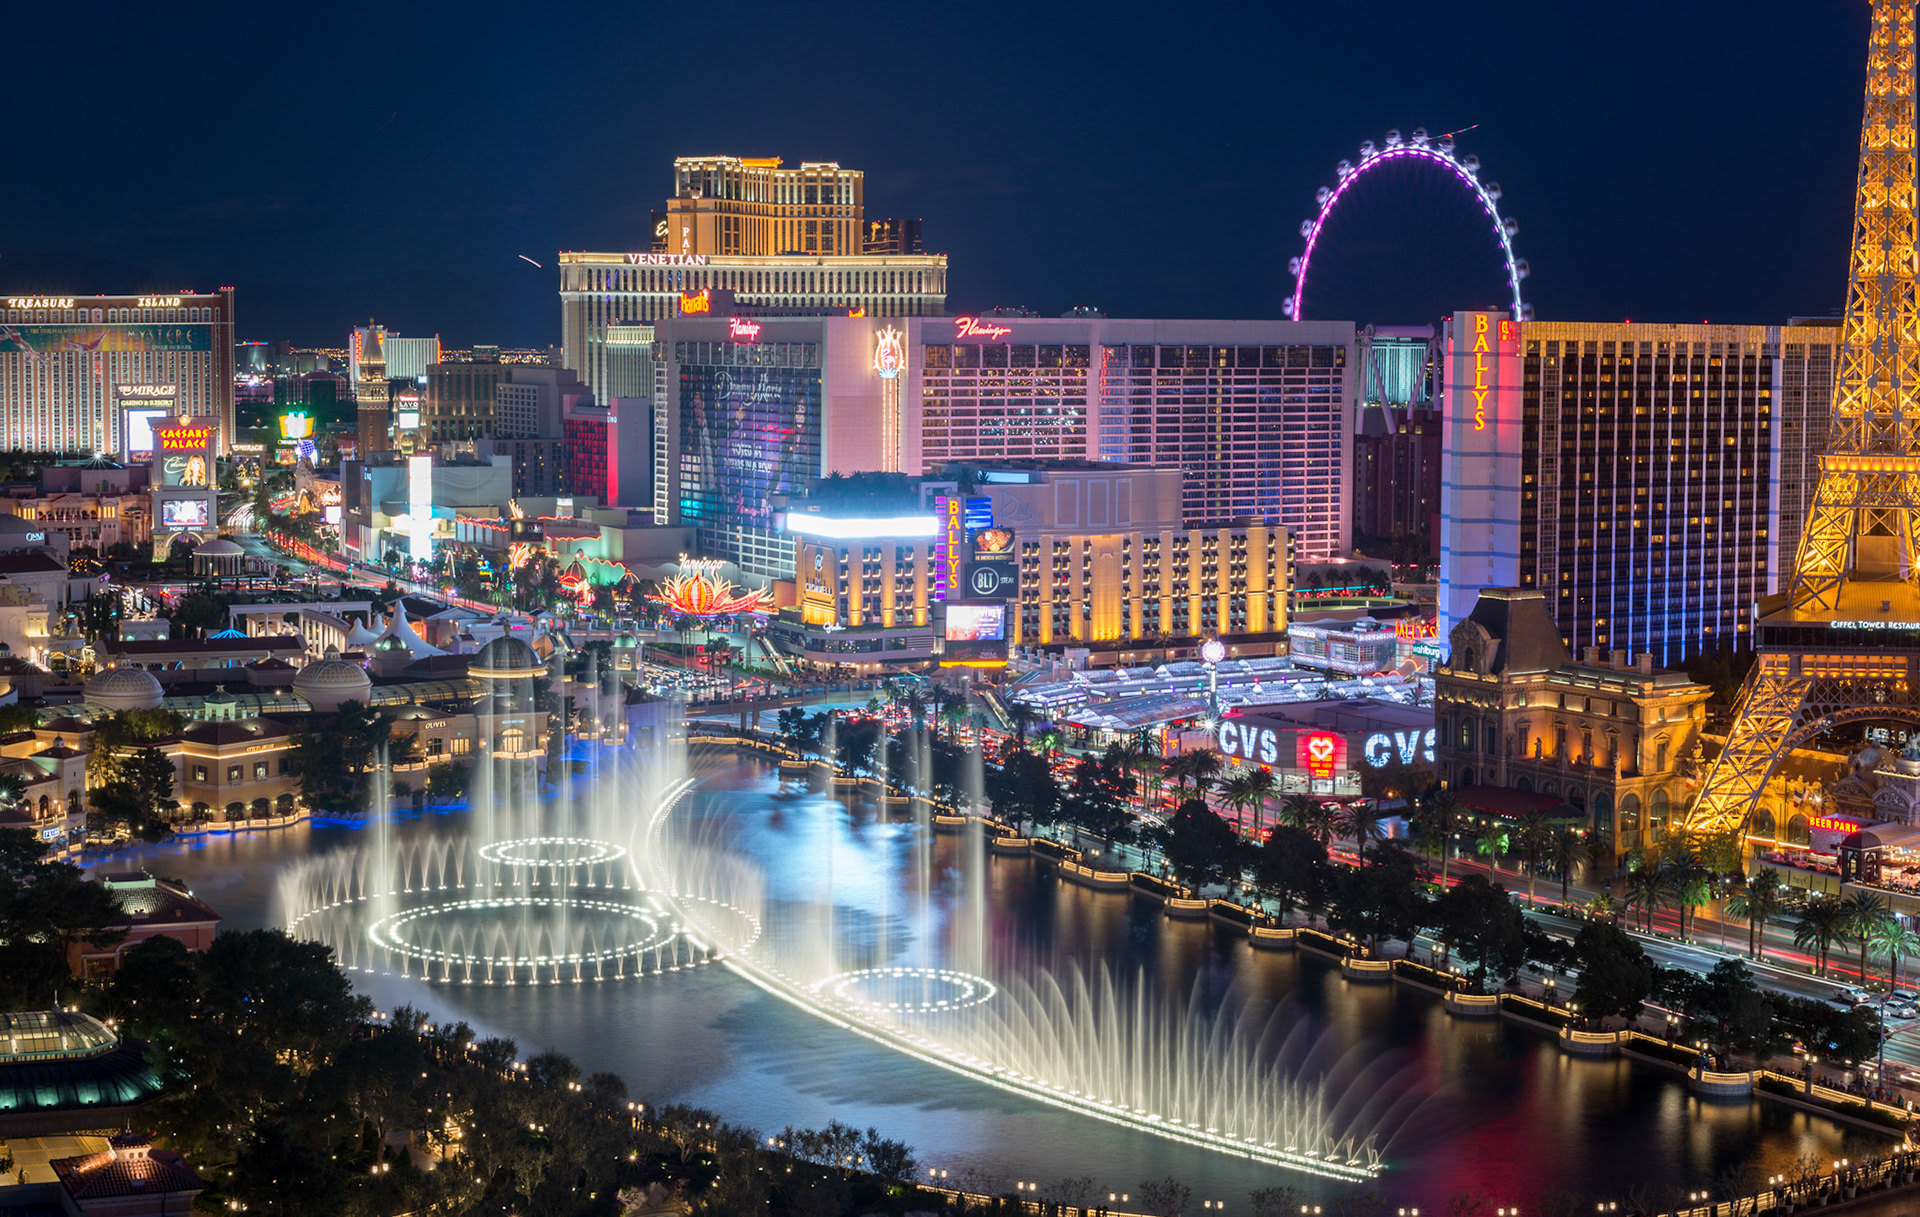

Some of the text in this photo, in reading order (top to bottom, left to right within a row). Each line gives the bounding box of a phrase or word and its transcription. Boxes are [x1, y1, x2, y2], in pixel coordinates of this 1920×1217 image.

[628, 254, 706, 265] VENETIAN
[8, 298, 181, 308] TREASURE ISLAND
[730, 318, 760, 341] Flamingo
[954, 316, 1012, 340] Flamingo
[1472, 314, 1490, 430] BALLYS
[123, 385, 176, 396] MIRAGE
[160, 429, 208, 438] CAESARS
[163, 440, 206, 449] PALACE
[947, 500, 960, 589] BALLYS
[978, 573, 993, 588] BLT
[1395, 621, 1436, 638] BALLY'S
[1831, 620, 1856, 628] EIFFEL
[1858, 621, 1885, 629] TOWER
[425, 721, 447, 729] OLIVES
[1219, 721, 1278, 763] CVS
[1809, 817, 1857, 833] BEER PARK
